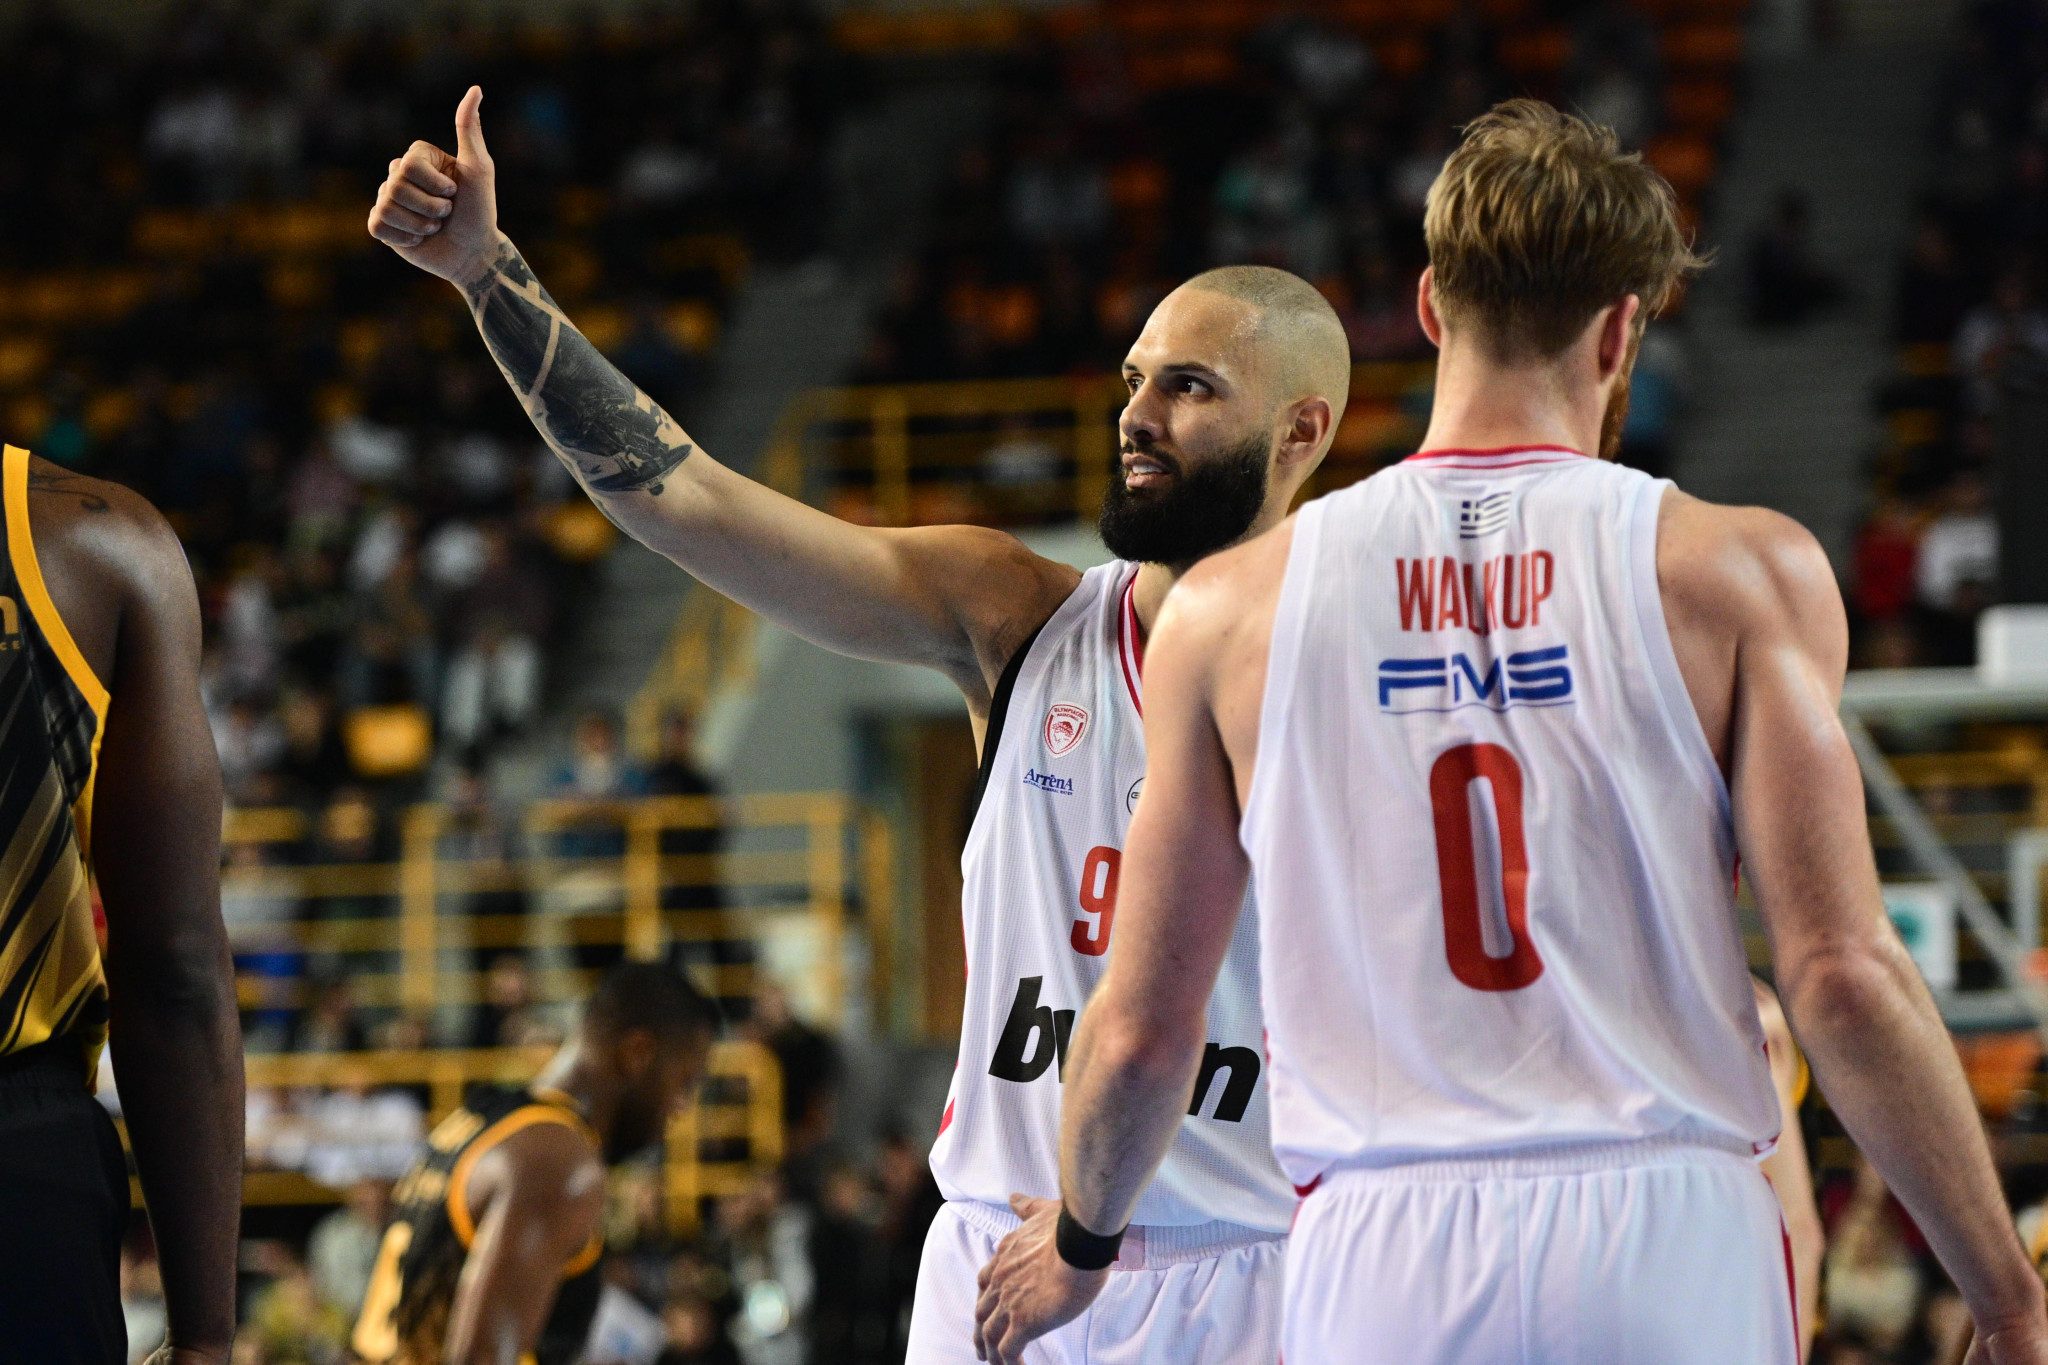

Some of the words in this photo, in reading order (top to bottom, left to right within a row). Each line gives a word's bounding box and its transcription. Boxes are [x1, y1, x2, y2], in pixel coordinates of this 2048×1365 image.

[1396, 550, 1555, 634] WALKUP
[1053, 707, 1085, 719] OLYMPIACOS
[1378, 645, 1573, 707] FMS
[1429, 743, 1544, 991] 0
[988, 975, 1261, 1123] bn
